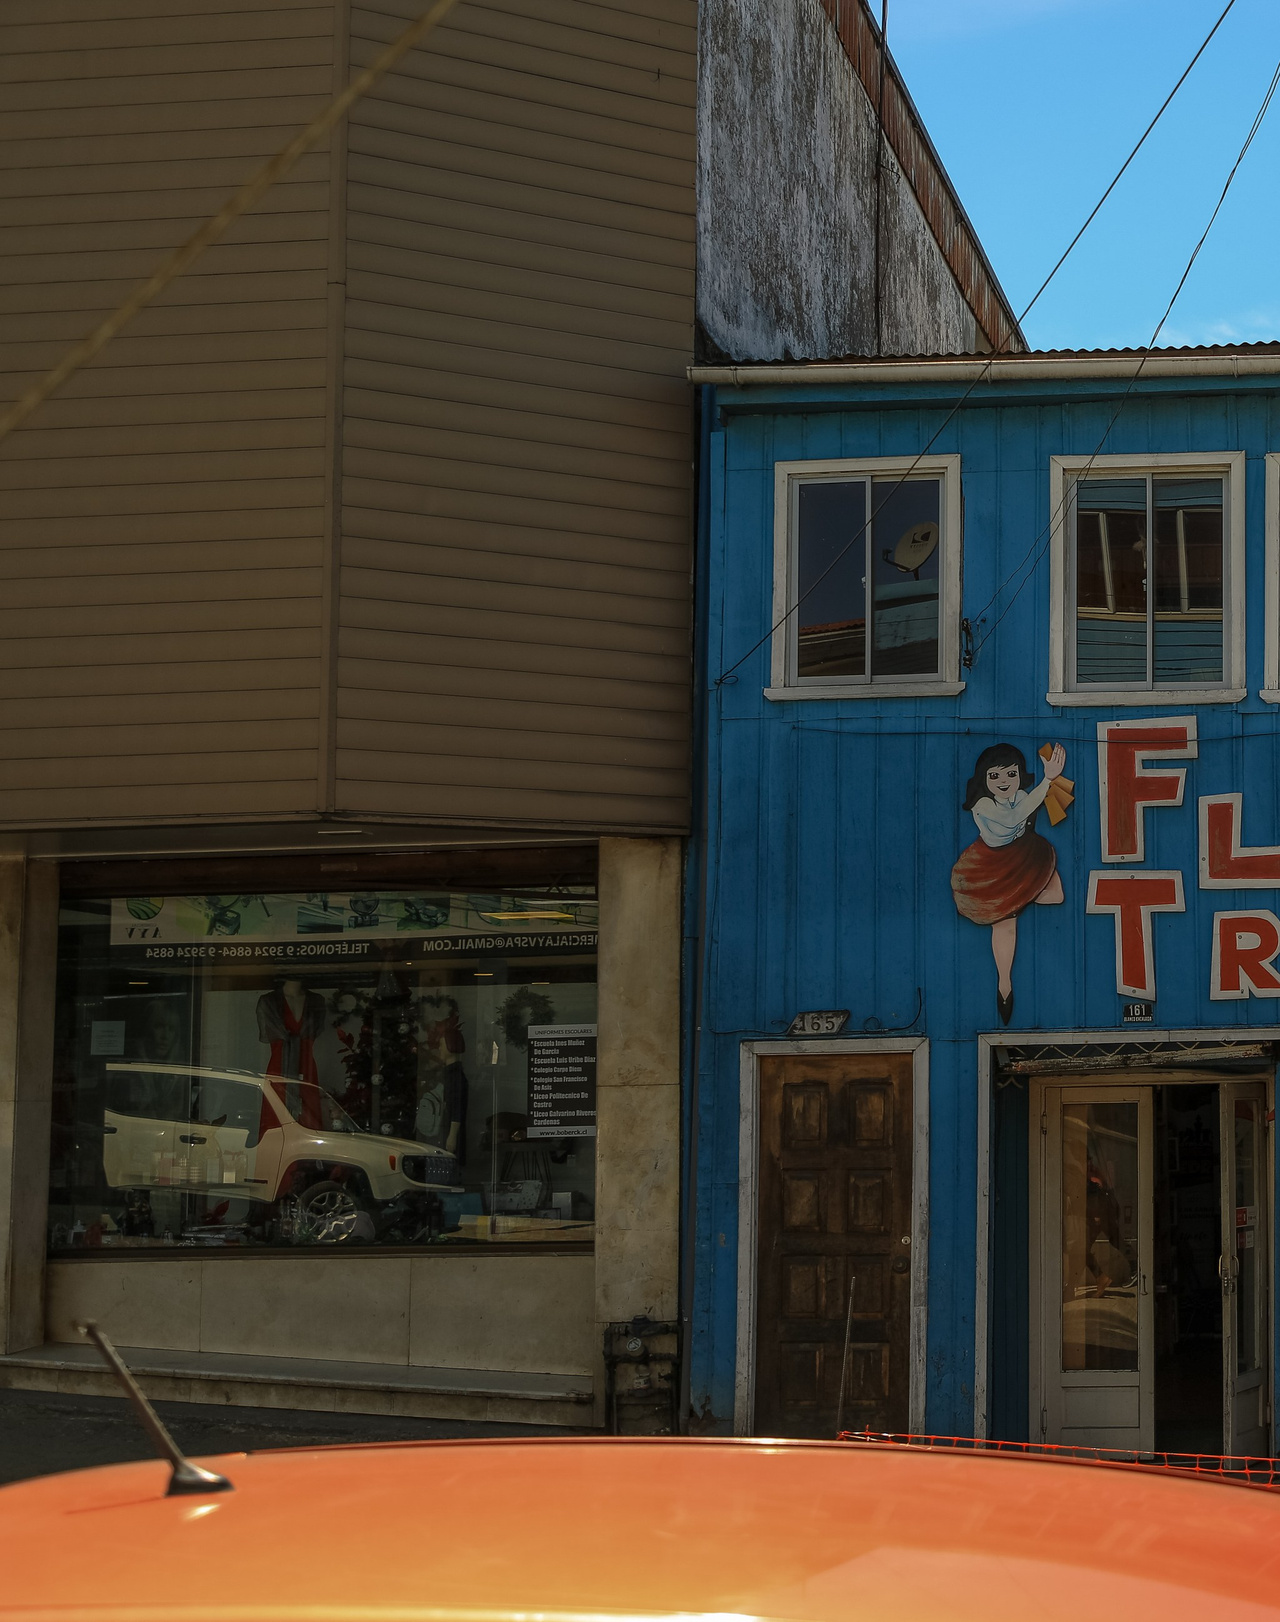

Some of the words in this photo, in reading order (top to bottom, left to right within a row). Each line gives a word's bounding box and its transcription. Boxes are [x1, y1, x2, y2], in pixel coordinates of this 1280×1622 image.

[1129, 1004, 1146, 1016] 161
[798, 1014, 835, 1031] 165
[534, 1076, 552, 1084] Colegio
